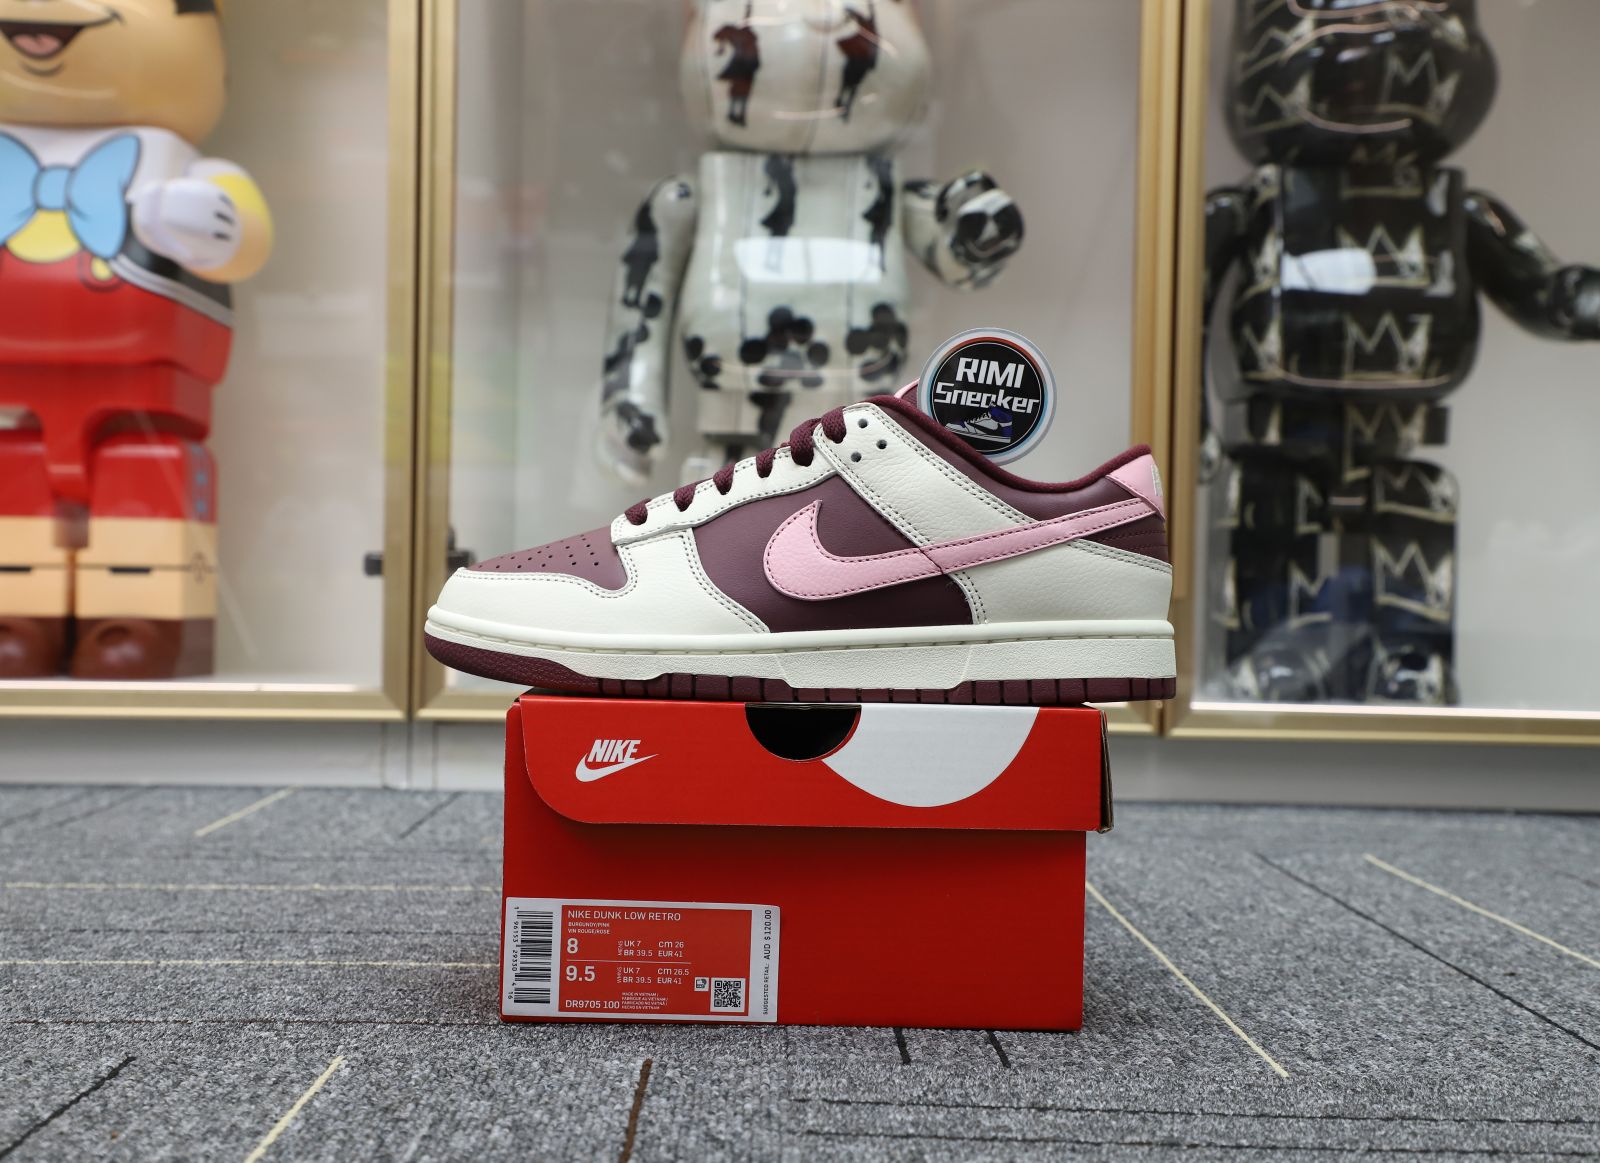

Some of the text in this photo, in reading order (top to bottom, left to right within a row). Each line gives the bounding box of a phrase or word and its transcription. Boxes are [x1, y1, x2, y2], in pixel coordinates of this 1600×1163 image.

[955, 357, 1025, 388] RIMI
[587, 739, 641, 763] NIKE
[567, 910, 681, 921] NIKE DUNK LOW RETRO
[566, 938, 578, 954] 8
[565, 965, 595, 982] 9.5
[565, 1000, 619, 1009] DR9705 100
